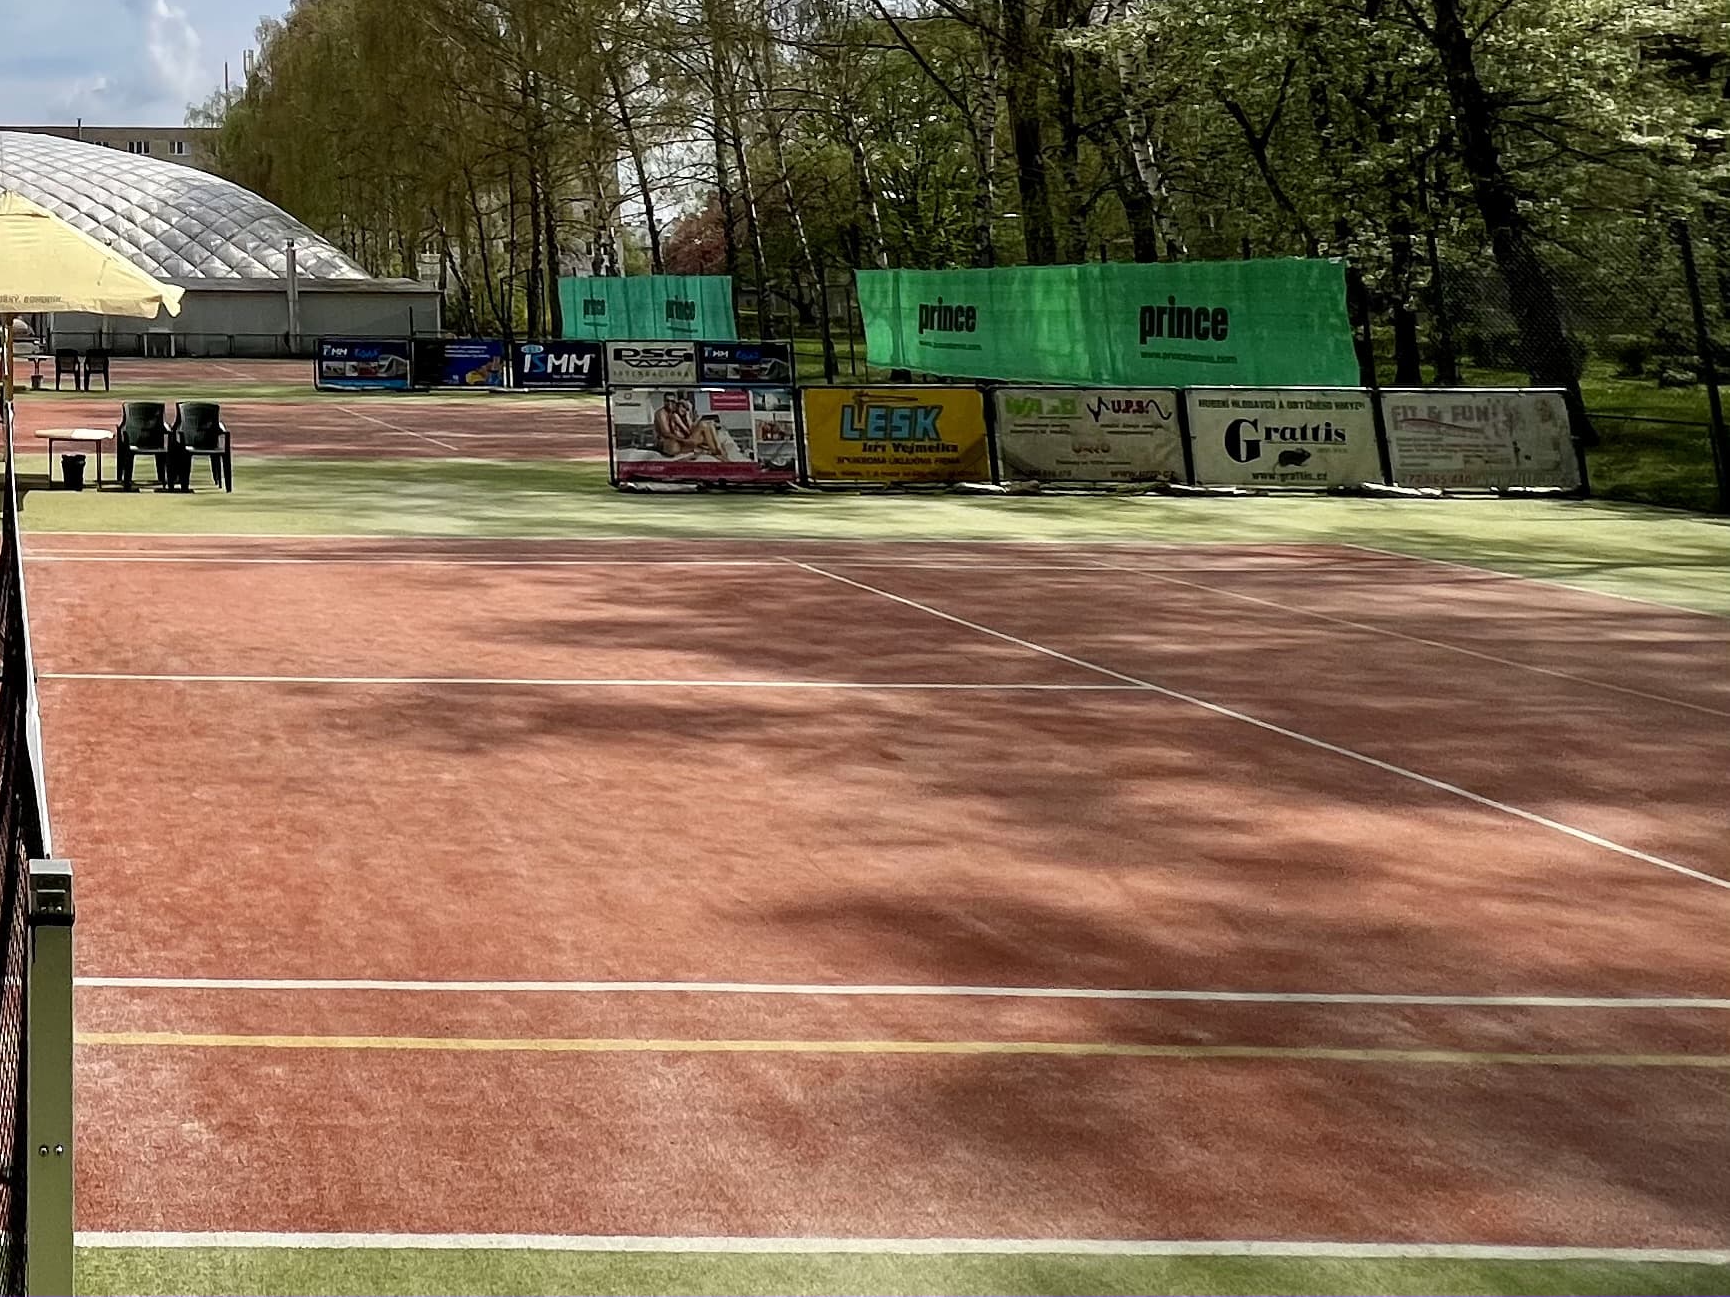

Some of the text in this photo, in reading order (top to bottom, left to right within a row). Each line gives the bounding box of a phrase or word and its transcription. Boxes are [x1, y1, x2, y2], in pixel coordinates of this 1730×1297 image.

[918, 296, 977, 335] prince
[1139, 295, 1231, 345] prince
[523, 354, 591, 373] ISMM
[841, 405, 943, 441] LESK
[1224, 418, 1347, 463] Grattis
